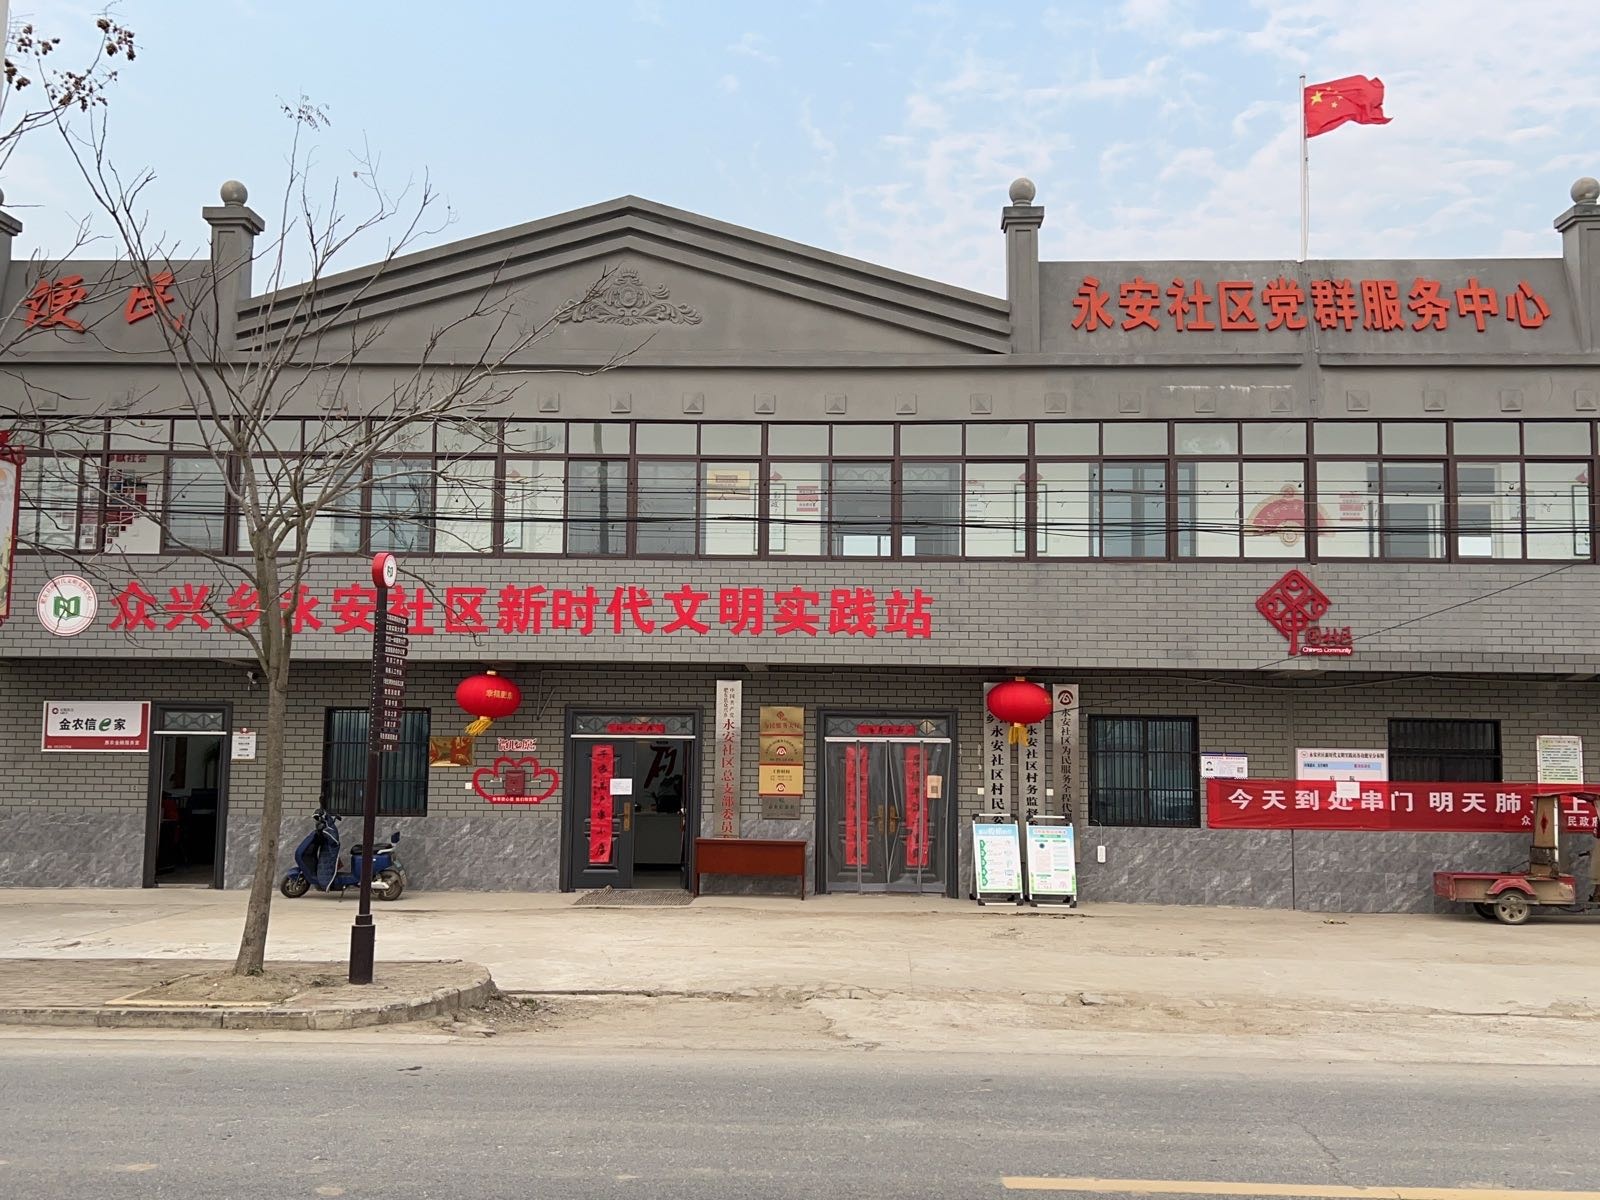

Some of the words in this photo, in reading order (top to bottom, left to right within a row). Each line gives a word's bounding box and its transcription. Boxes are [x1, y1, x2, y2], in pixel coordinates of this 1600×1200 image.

[1071, 275, 1552, 333] 永安社区党群服务中心
[108, 581, 934, 639] 众兴乡永安社区新时代文明实践站
[59, 717, 126, 732] 金农信e家
[720, 718, 736, 838] 永安社区总支部委员
[1227, 788, 1415, 813] 今天到处串门
[1429, 790, 1590, 815] 明天肺上
